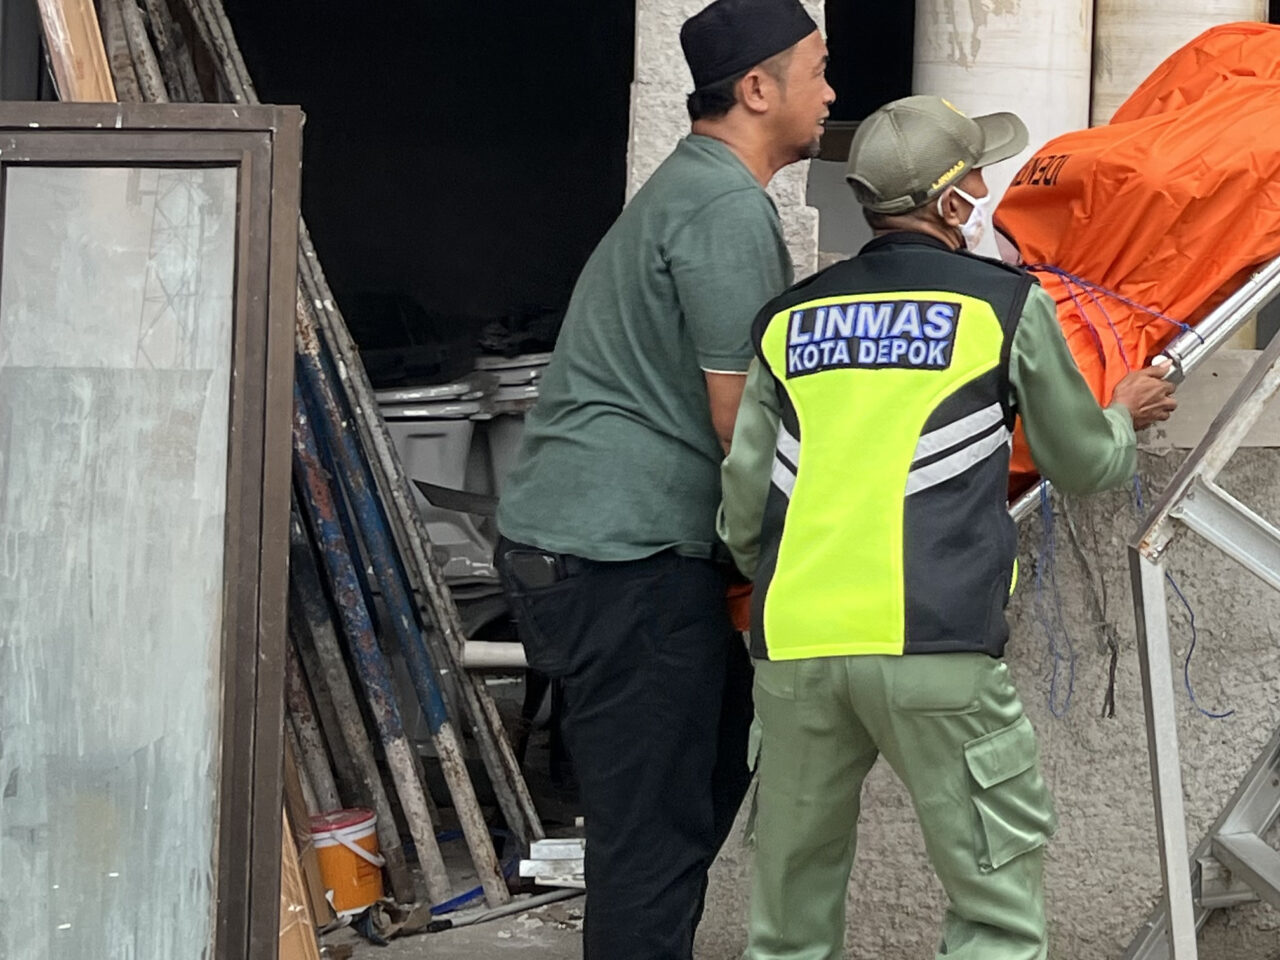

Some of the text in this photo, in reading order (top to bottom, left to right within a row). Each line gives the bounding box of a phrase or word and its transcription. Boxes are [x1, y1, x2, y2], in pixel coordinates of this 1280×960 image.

[932, 160, 965, 190] LINMAS
[789, 302, 954, 345] LINMAS
[788, 339, 950, 373] KOTA DEPOK
